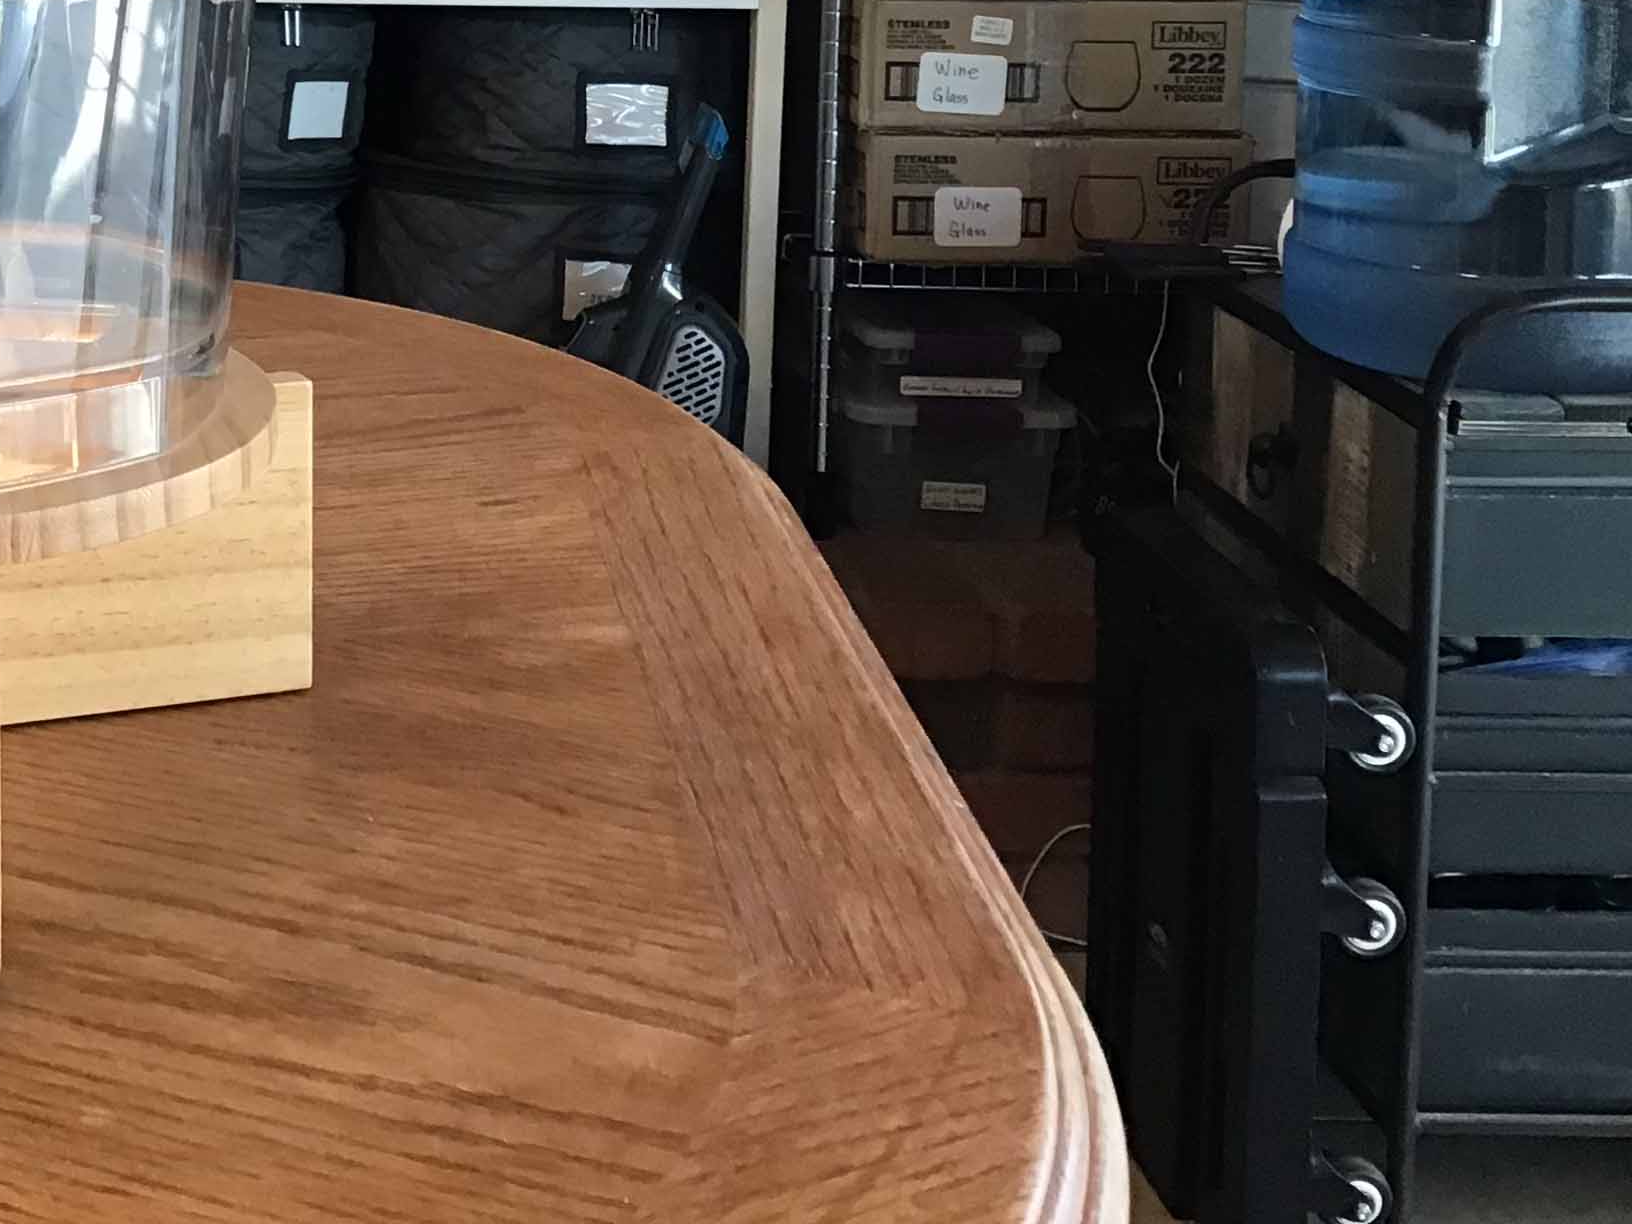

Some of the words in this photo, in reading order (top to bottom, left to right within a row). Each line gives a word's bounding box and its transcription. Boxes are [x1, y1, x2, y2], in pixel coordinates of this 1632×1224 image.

[1160, 26, 1224, 46] Libbey
[934, 58, 980, 81] Wine
[1168, 52, 1226, 73] 222
[932, 85, 970, 105] Glass
[1164, 161, 1227, 181] Libbey
[953, 196, 992, 213] Wine
[948, 219, 988, 240] Glass
